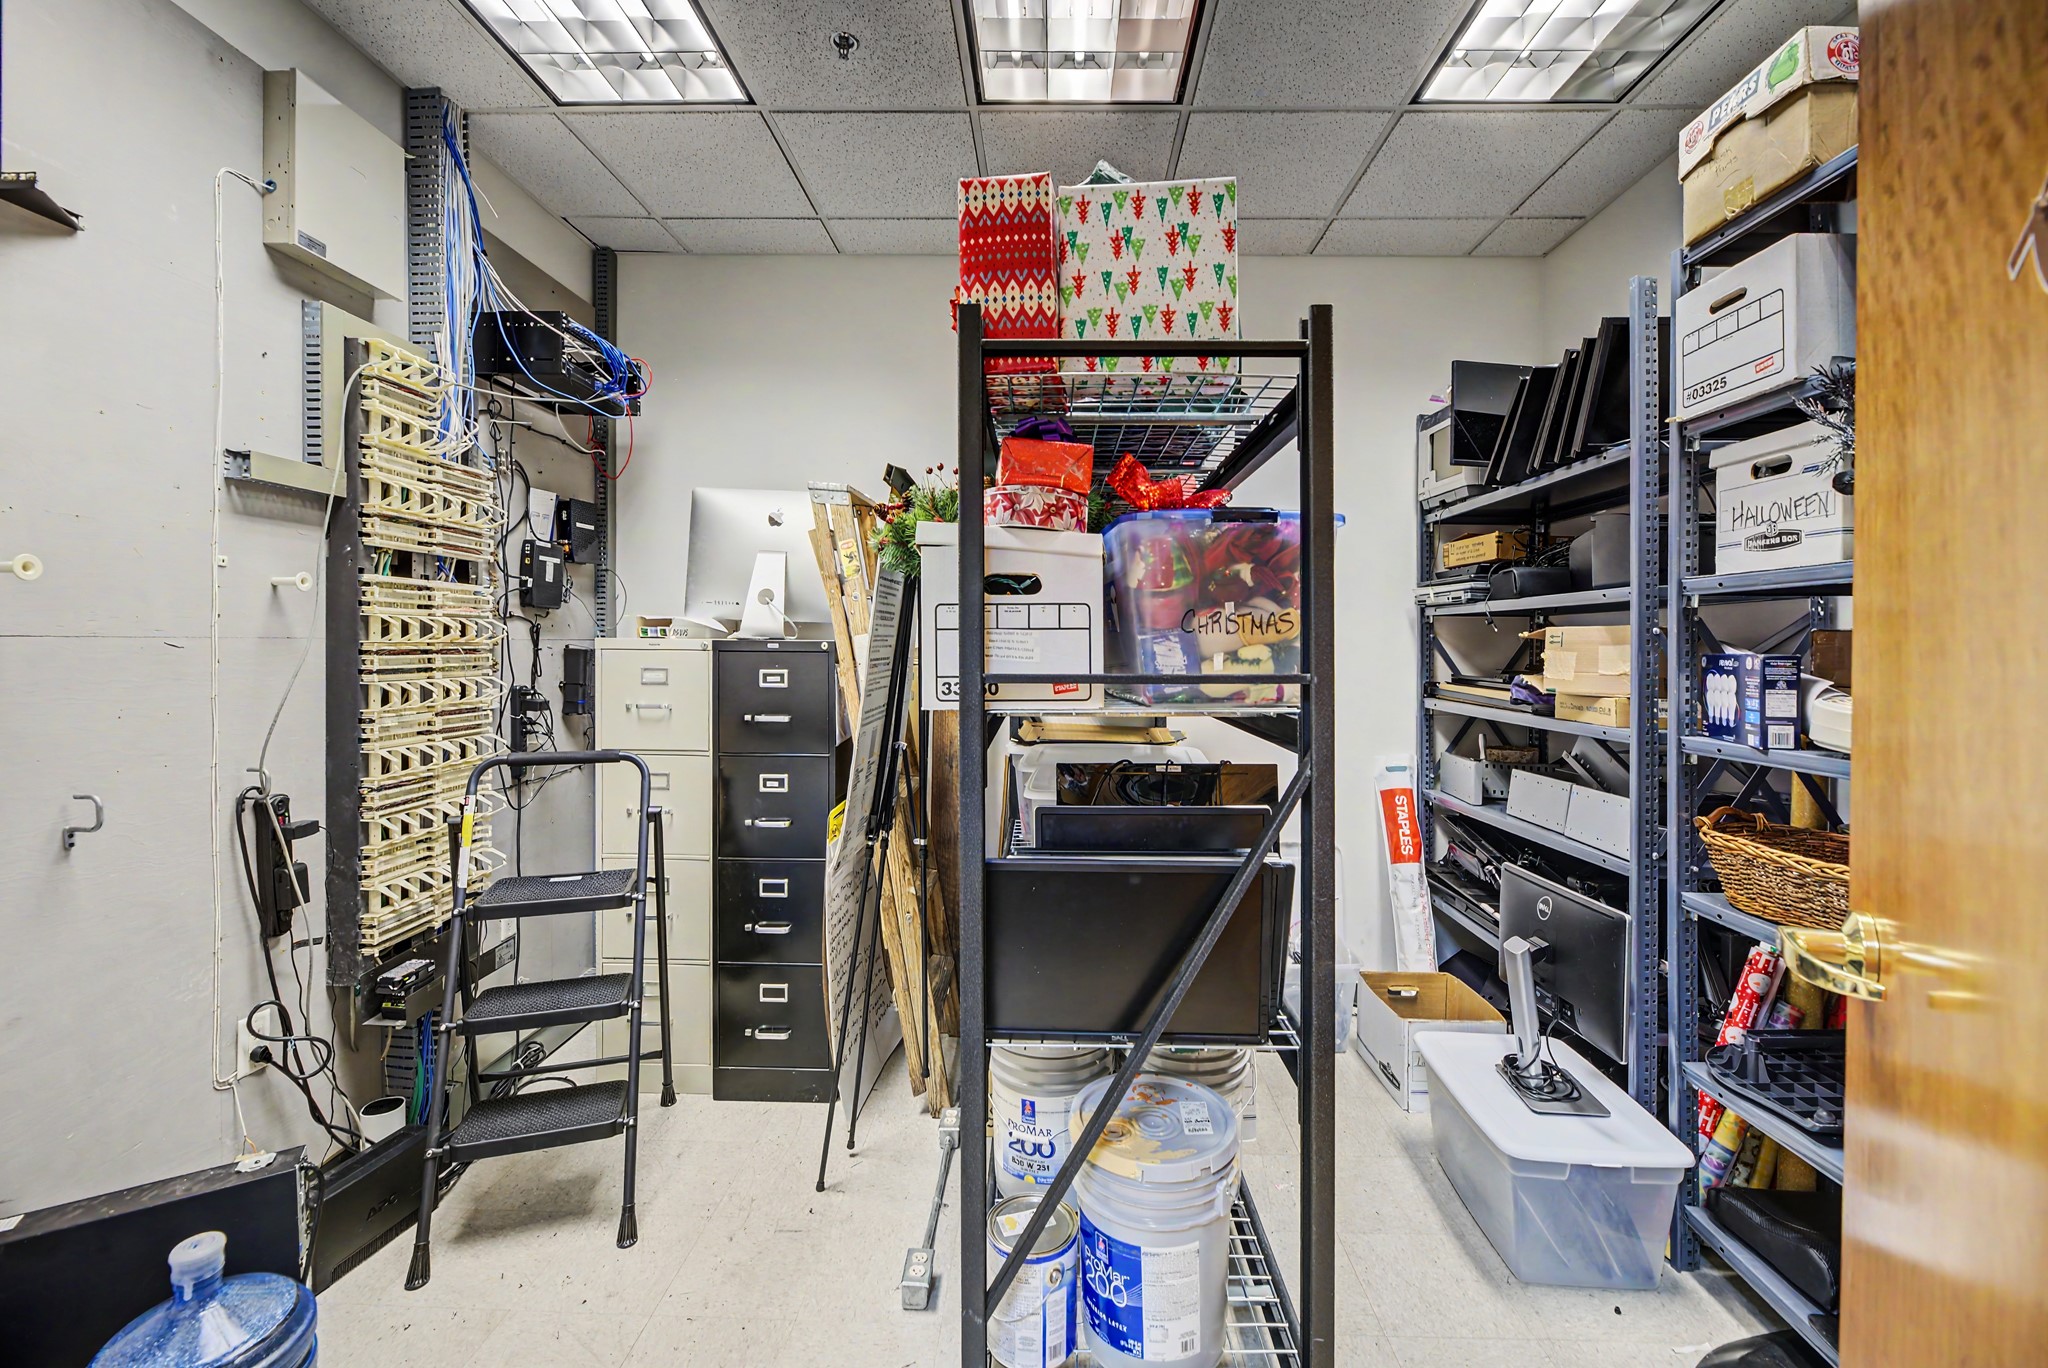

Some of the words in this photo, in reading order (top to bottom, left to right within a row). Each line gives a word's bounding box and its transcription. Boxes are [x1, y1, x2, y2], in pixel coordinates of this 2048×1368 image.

[1686, 376, 1727, 401] #03325
[1732, 492, 1829, 532] HALLOWEEN
[1181, 608, 1295, 636] CHRISTMAS
[1395, 795, 1414, 856] STAPLES
[1086, 1259, 1128, 1308] 200
